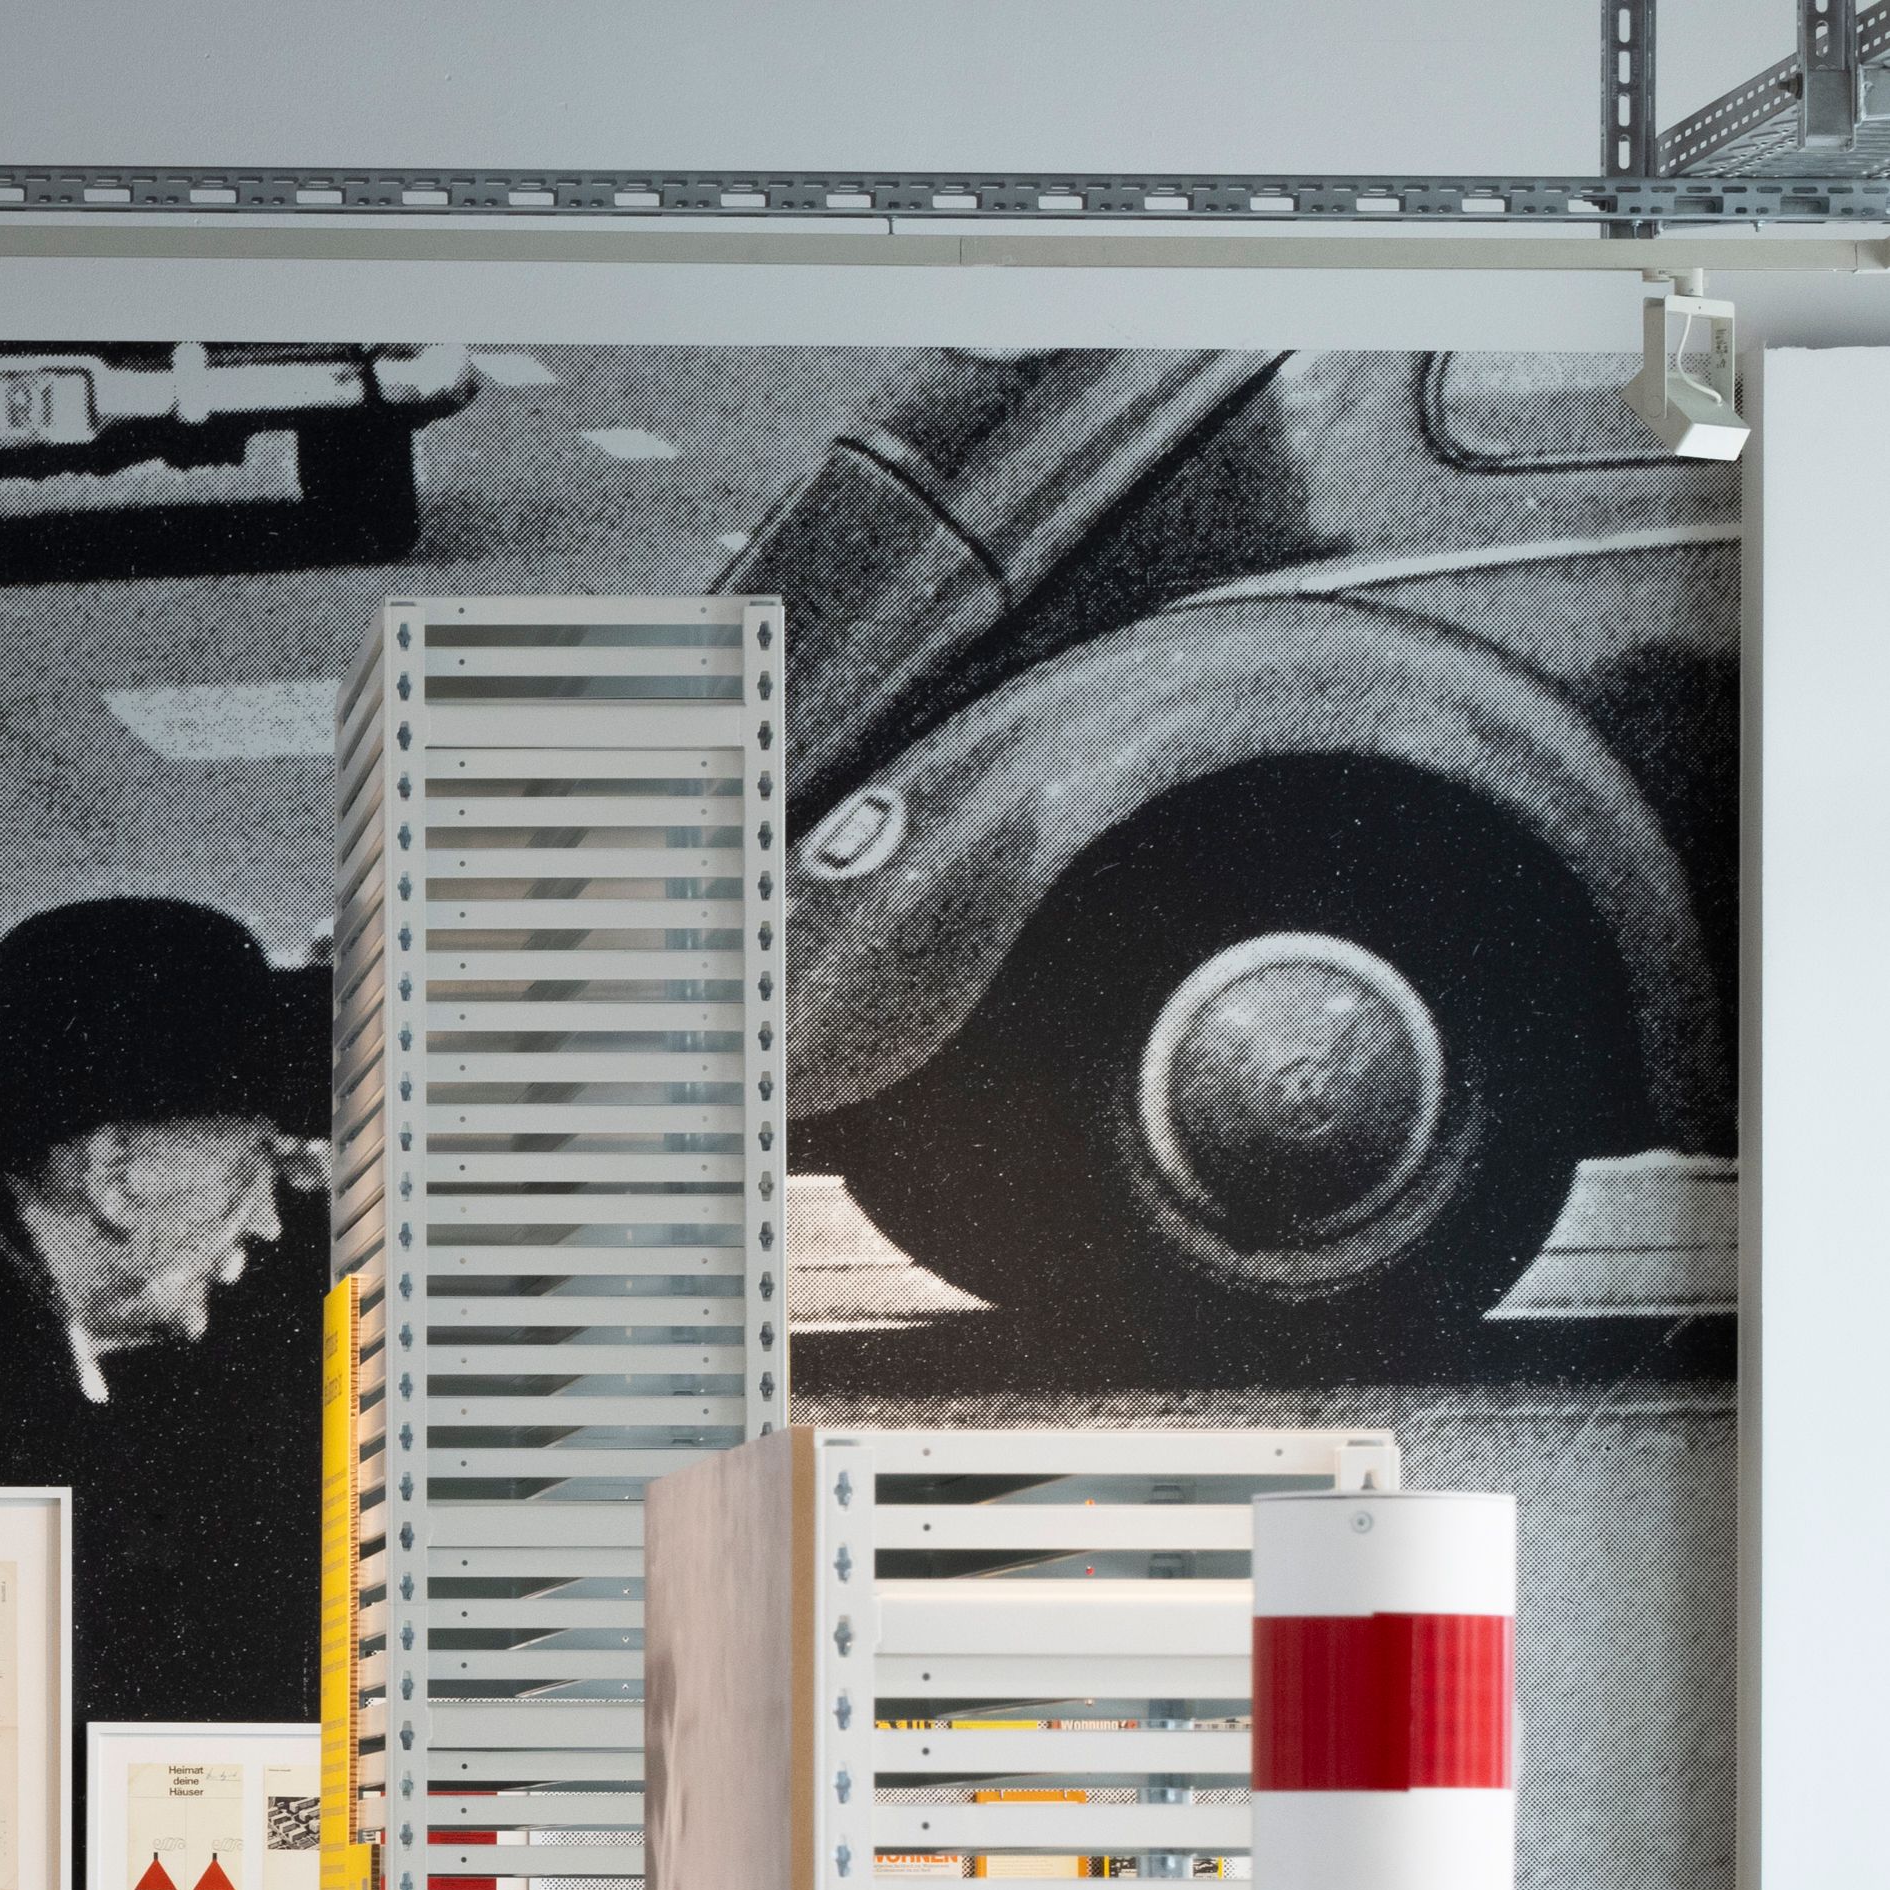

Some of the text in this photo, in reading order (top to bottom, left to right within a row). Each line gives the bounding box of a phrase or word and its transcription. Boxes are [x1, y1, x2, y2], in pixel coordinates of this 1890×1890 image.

[168, 1766, 204, 1775] Heimat
[173, 1777, 199, 1786] deine
[169, 1788, 204, 1796] Häuser
